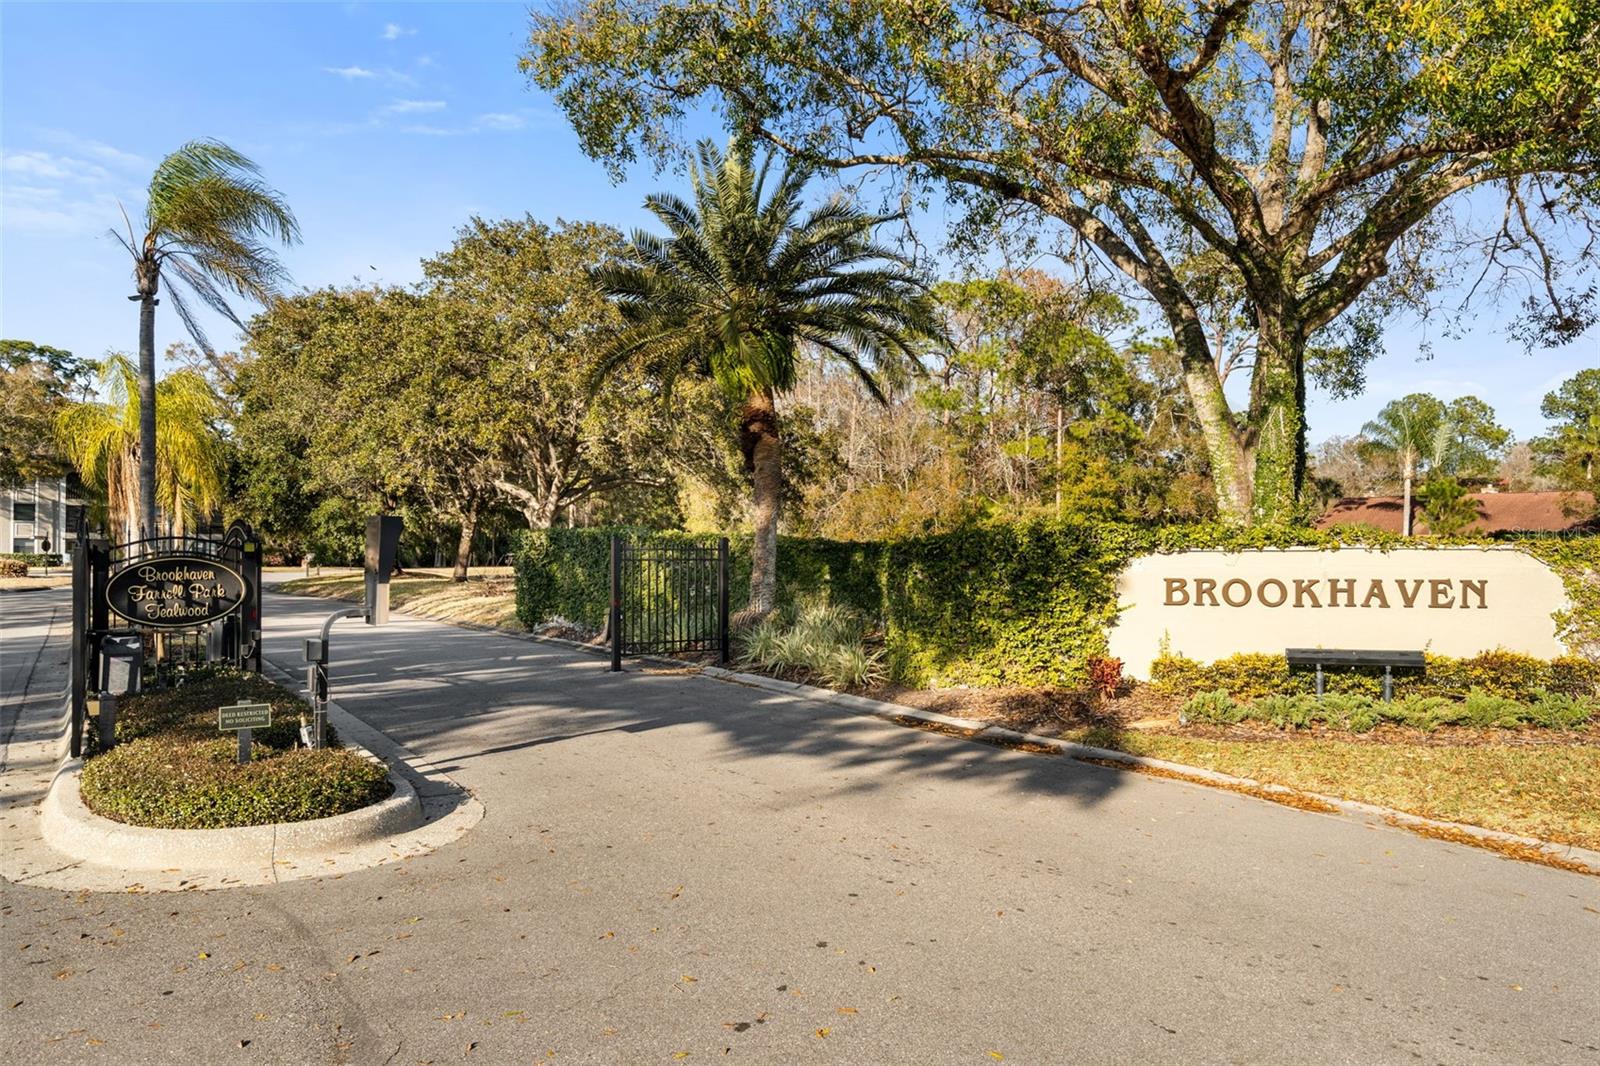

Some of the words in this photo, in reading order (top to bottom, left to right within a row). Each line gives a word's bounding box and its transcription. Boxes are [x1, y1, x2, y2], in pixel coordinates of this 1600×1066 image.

[138, 566, 216, 582] Brookhaven
[127, 584, 184, 602] Farrell
[188, 583, 226, 599] Park
[1163, 577, 1489, 609] BROOKHAVEN
[144, 602, 209, 619] Tealwood
[222, 711, 236, 719] DEED
[237, 709, 269, 717] RESTRICTED
[235, 715, 266, 723] SOLICITING
